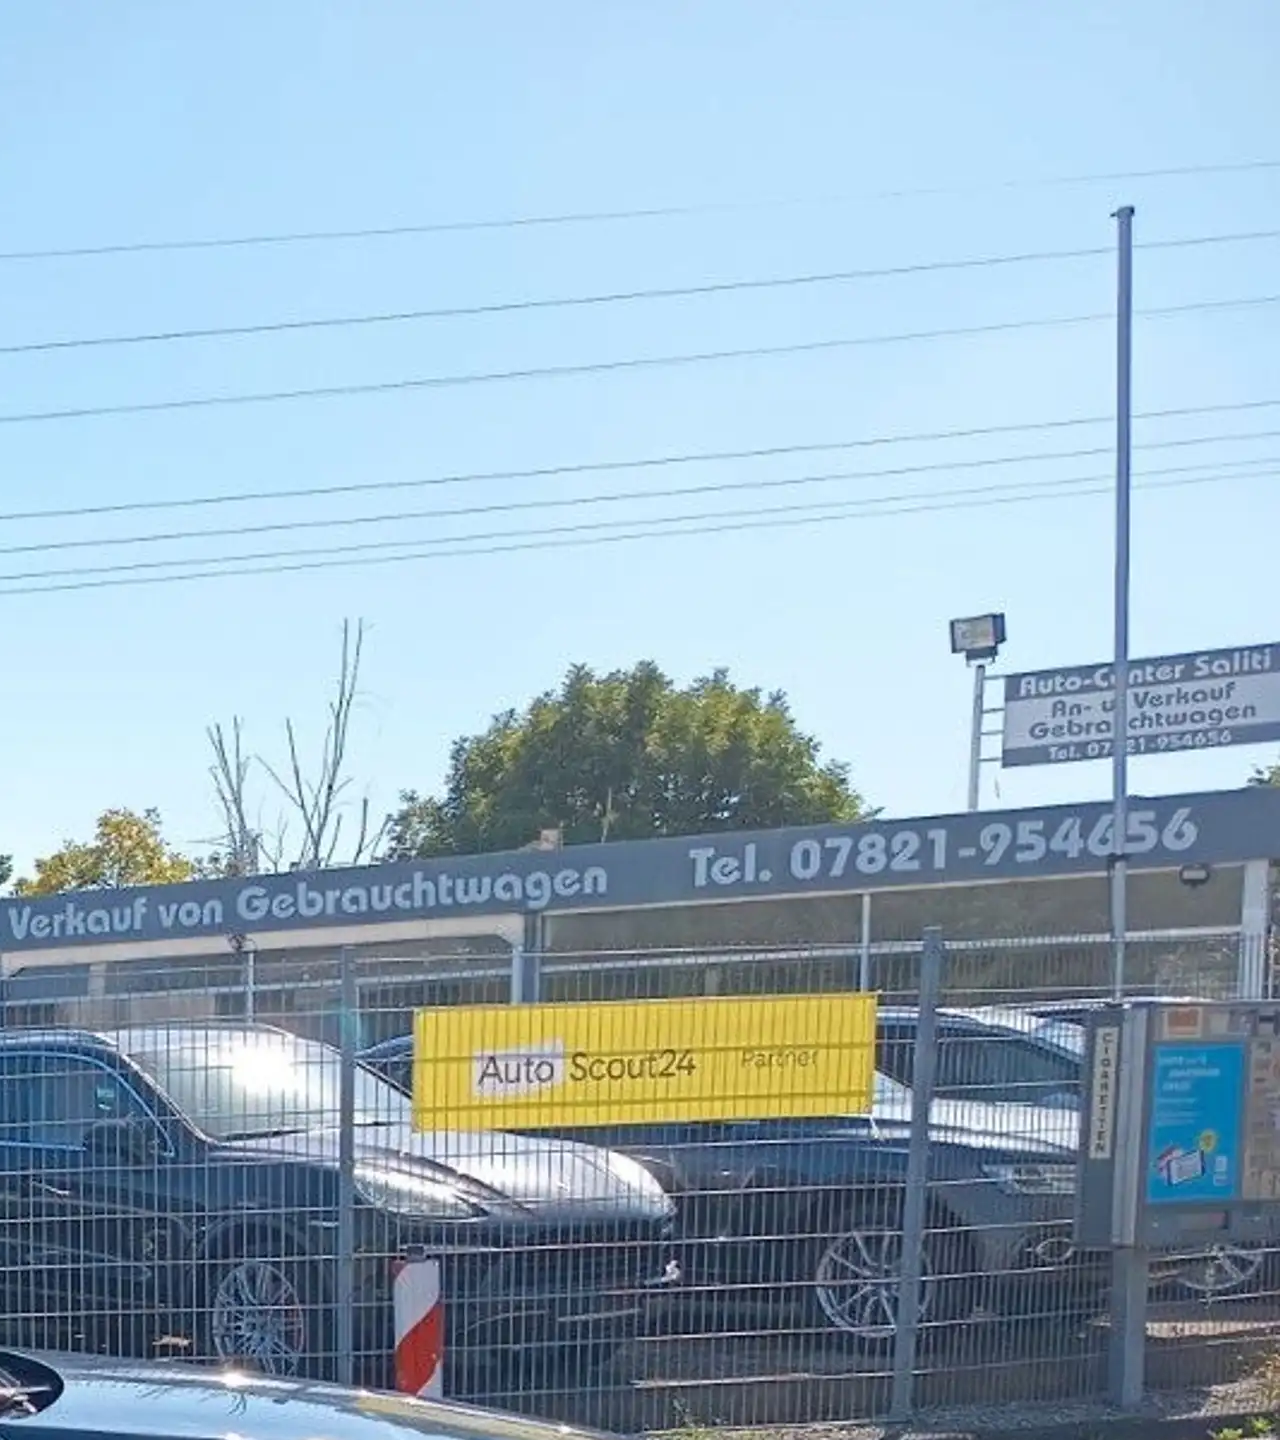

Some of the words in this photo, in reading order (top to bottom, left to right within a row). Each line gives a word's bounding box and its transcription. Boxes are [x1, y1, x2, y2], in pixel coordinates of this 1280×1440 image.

[1019, 663, 1185, 697] Auto-Cnter
[1194, 650, 1272, 678] Saliti
[1051, 699, 1091, 718] An-
[1133, 681, 1236, 709] Verkauf
[1028, 703, 1257, 740] Gebrachtwagen
[1048, 745, 1081, 760] Tel.
[1087, 729, 1233, 756] 0721-954656
[690, 846, 772, 888] Tel.
[790, 807, 1198, 880] 07821-954656
[8, 896, 148, 941] Verkauf
[157, 899, 223, 927] von
[237, 866, 608, 922] Gebrauchtwagen
[477, 1053, 556, 1086] Auto
[569, 1048, 697, 1083] Scout24
[740, 1048, 818, 1068] Partner
